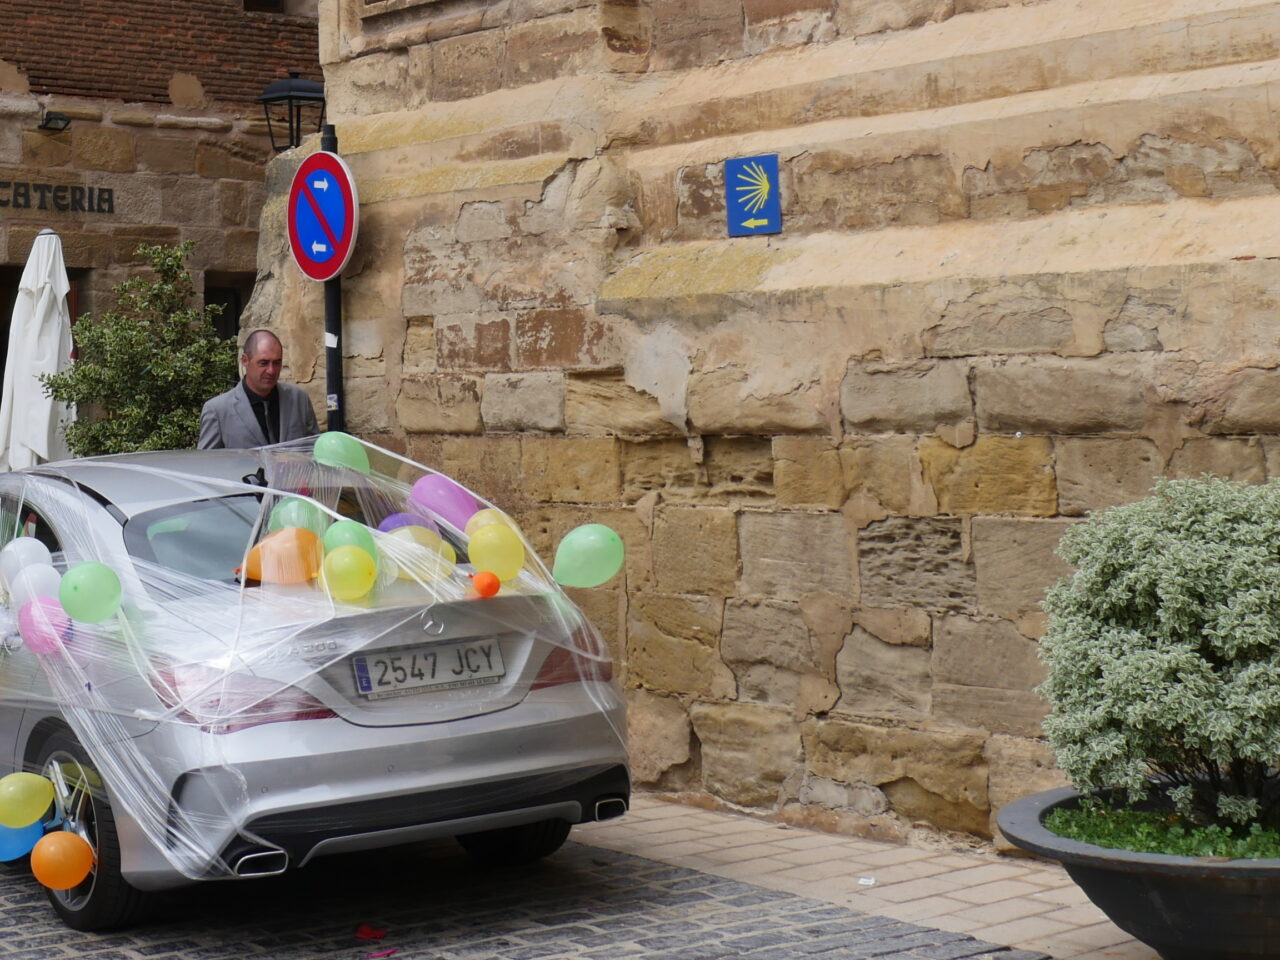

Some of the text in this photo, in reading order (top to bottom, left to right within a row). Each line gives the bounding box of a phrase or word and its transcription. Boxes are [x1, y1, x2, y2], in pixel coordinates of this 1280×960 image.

[374, 644, 493, 687] 2547 JCY
[362, 678, 369, 687] E
